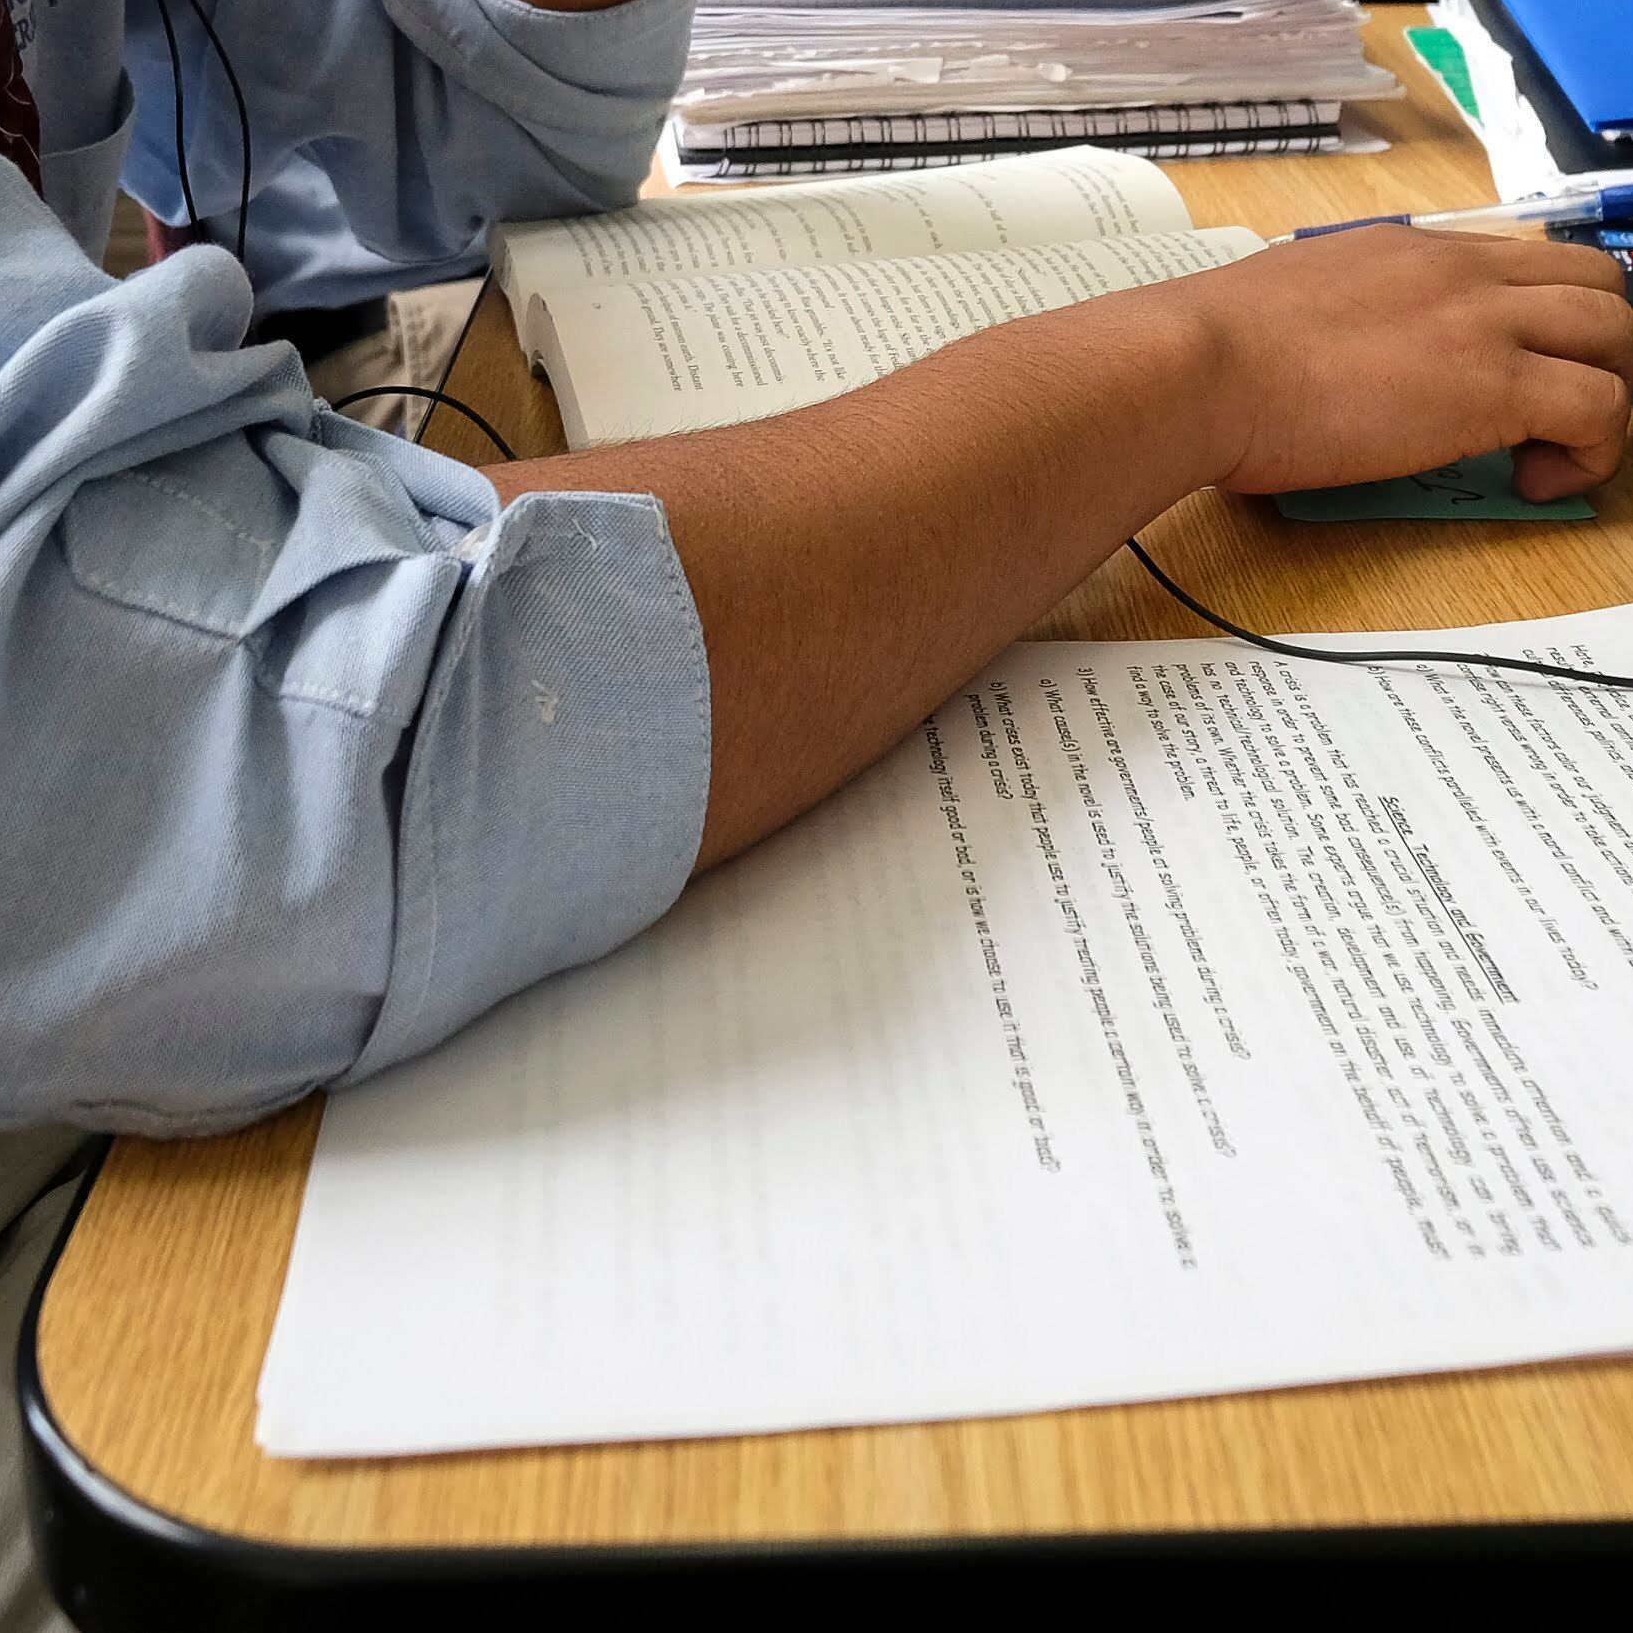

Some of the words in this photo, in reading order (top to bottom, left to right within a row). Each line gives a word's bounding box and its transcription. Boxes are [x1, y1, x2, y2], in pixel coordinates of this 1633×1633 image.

[663, 354, 682, 391] somewhere
[688, 365, 703, 390] Distant
[732, 372, 745, 387] here
[1075, 667, 1095, 677] 3)
[1126, 665, 1149, 683] find
[1151, 664, 1170, 679] the
[1224, 661, 1246, 677] and
[1273, 660, 1289, 668] A
[1367, 663, 1386, 676] b)
[1416, 663, 1439, 672] a)
[988, 682, 1008, 692] b)
[1039, 678, 1058, 689] a)
[1080, 677, 1098, 696] How
[1170, 663, 1204, 700] problems
[1248, 661, 1277, 696] response
[1279, 670, 1301, 691] crisis
[1374, 675, 1395, 693] How
[1420, 671, 1450, 695] What
[1044, 689, 1066, 713] What
[1137, 690, 1154, 707] way
[1158, 680, 1177, 700] case
[1234, 678, 1266, 721] technology
[1293, 694, 1308, 702] is
[1387, 693, 1405, 707] are
[1440, 696, 1456, 705] in
[994, 692, 1015, 717] What
[1168, 701, 1188, 711] of
[1194, 701, 1215, 712] of
[1270, 698, 1285, 707] in
[1448, 705, 1467, 720] the
[1507, 694, 1534, 717] these
[1574, 685, 1619, 719] external
[1089, 697, 1115, 738] effective
[1145, 708, 1160, 719] to
[1173, 713, 1191, 728] our
[1200, 713, 1217, 725] its
[1276, 708, 1298, 730] order
[1398, 708, 1422, 732] these
[1002, 718, 1022, 745] crises
[1053, 715, 1081, 753] cause(s)
[1150, 720, 1172, 742] solve
[1258, 723, 1273, 733] to
[1291, 733, 1306, 744] to
[1300, 711, 1333, 746] problem
[1459, 721, 1489, 744] novel
[1526, 718, 1562, 750] factors
[924, 727, 949, 776] technology
[963, 694, 990, 729] problem
[979, 729, 999, 760] during
[990, 768, 1014, 800] crisis?
[1106, 739, 1122, 755] are
[1161, 743, 1180, 759] the
[1264, 735, 1286, 758] solve
[1415, 734, 1451, 774] conflicts
[1011, 747, 1031, 771] exist
[1066, 753, 1083, 763] in
[1200, 662, 1217, 677] has
[1209, 680, 1223, 691] no
[1216, 694, 1281, 793] technical/technological
[1297, 845, 1315, 867] The
[1218, 747, 1247, 787] Whether
[1293, 746, 1330, 782] prevent
[1327, 749, 1348, 770] that
[1472, 745, 1514, 785] presents
[1480, 693, 1507, 713] right
[1499, 715, 1528, 742] versus
[1520, 743, 1548, 771] wrong
[1541, 771, 1557, 782] in
[1549, 782, 1578, 809] order
[1572, 811, 1588, 823] to
[1553, 752, 1580, 773] color
[937, 777, 961, 803] itself
[1019, 772, 1040, 800] today
[1199, 766, 1226, 796] threat
[1340, 773, 1360, 789] has
[1572, 776, 1594, 791] our
[1108, 756, 1163, 855] governments/people
[1319, 785, 1343, 810] some
[1438, 776, 1488, 822] paralleled
[939, 805, 967, 830] good
[1581, 794, 1632, 838] judgment
[951, 831, 966, 844] or
[1306, 813, 1330, 842] Some
[1413, 845, 1456, 904] Technology
[1450, 908, 1477, 928] and
[1465, 932, 1520, 1003] Government
